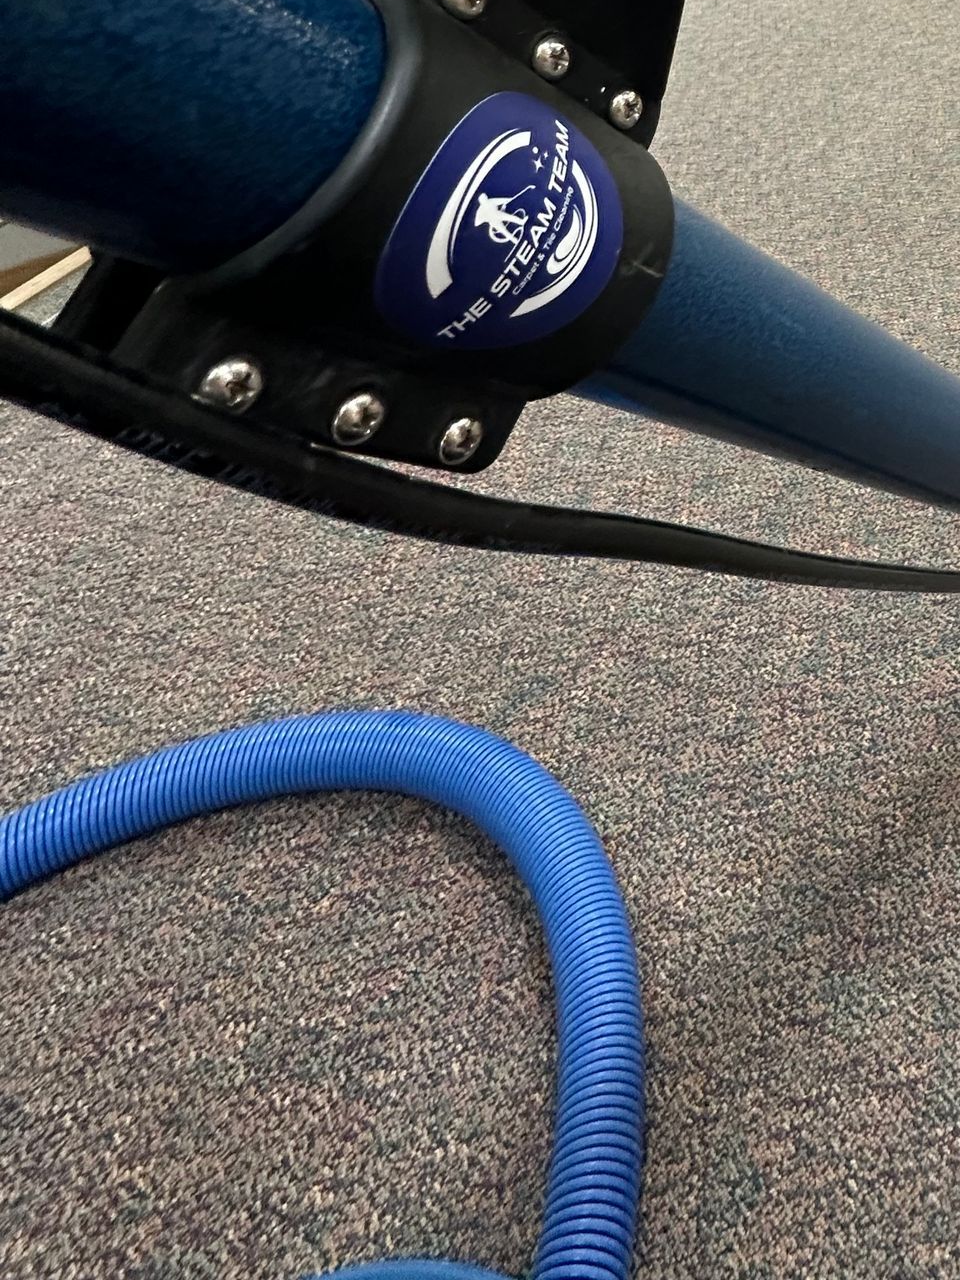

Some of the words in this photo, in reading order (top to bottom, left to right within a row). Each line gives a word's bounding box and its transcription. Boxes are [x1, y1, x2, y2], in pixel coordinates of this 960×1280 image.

[436, 297, 493, 339] THE
[490, 197, 557, 298] STEAM
[548, 120, 569, 193] TEAM
[512, 262, 540, 295] Carpet
[537, 252, 546, 262] &
[543, 232, 557, 250] Tile
[553, 186, 574, 231] Cleaning
